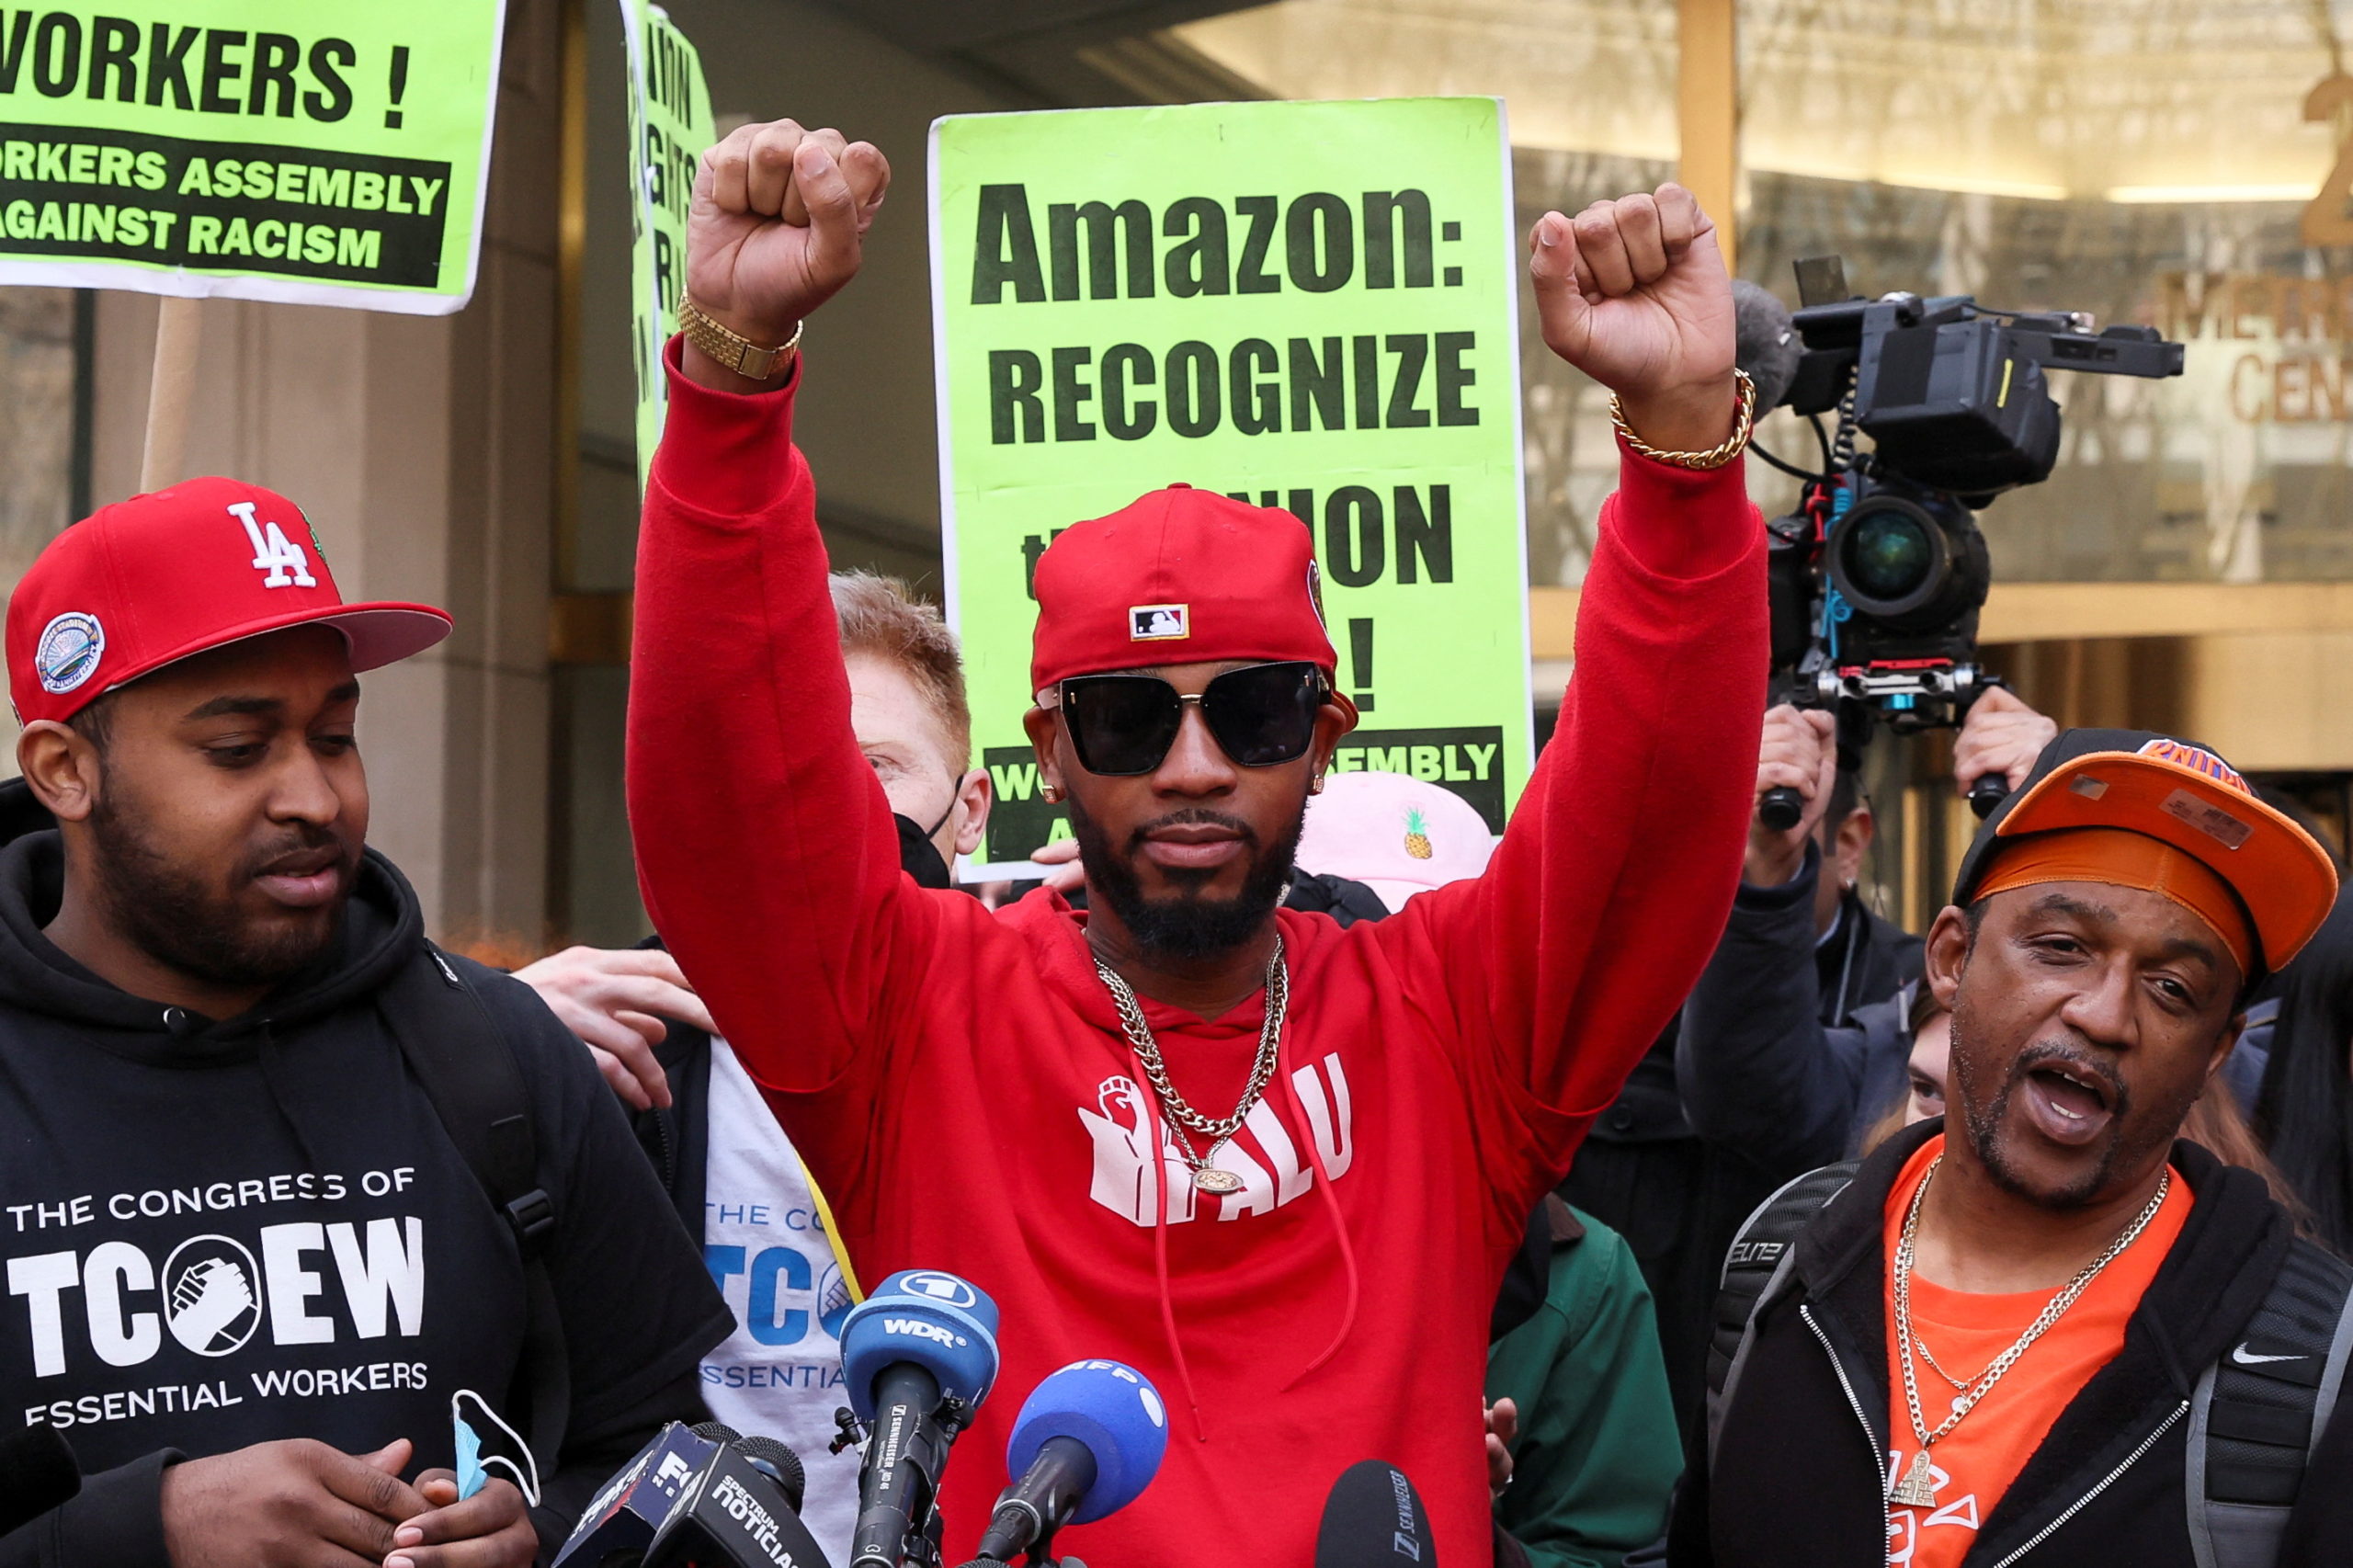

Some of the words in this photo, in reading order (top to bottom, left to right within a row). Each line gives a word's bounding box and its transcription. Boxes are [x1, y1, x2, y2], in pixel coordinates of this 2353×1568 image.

[384, 45, 410, 130] !
[0, 141, 167, 190] RKERS
[177, 157, 444, 216] ASSEMBLY
[0, 199, 177, 251] GAINST
[188, 215, 381, 268] RACISM
[971, 183, 1463, 305] Amazon:
[987, 330, 1481, 446] RECOGNIZE
[2230, 355, 2353, 422] CEN
[227, 502, 317, 589] LA
[1324, 743, 1497, 781] EMBLY
[6, 1195, 95, 1233] THE
[108, 1172, 347, 1221] CONGRESS
[361, 1166, 415, 1197] OF
[251, 1362, 428, 1398] WORKERS
[883, 1416, 903, 1469] SENNHEISER
[711, 1482, 799, 1568] NOTICIA
[722, 1474, 779, 1535] SPECTRUM
[1389, 1470, 1415, 1534] SENNHEISER
